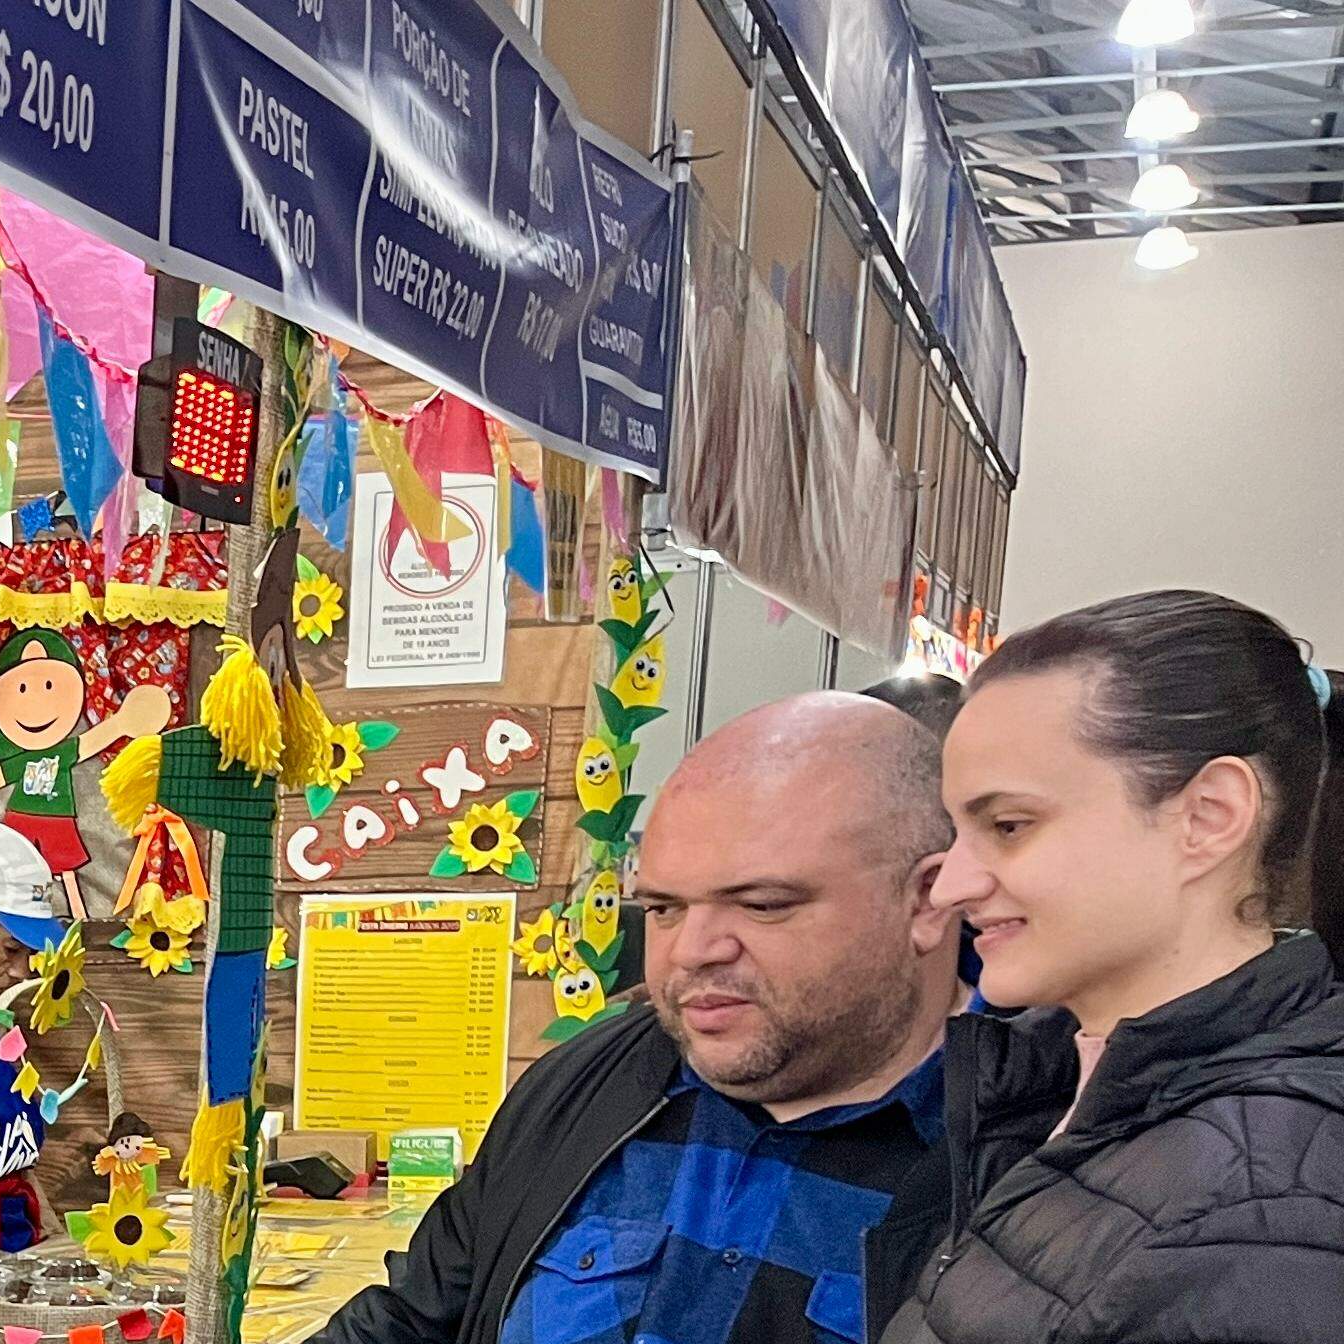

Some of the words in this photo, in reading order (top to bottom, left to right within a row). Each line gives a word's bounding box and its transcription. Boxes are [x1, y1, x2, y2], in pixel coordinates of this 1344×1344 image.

[392, 1, 451, 97] PORÇÃO
[452, 59, 472, 118] DE
[19, 49, 95, 152] 20,00
[238, 76, 314, 180] PASTEL
[373, 234, 430, 310] SUPER
[426, 268, 452, 327] R$
[446, 280, 485, 341] 22,00
[197, 331, 240, 387] SENHA
[381, 615, 419, 626] BEBIDAS
[382, 603, 423, 613] PROIBIDO
[424, 602, 431, 611] A
[432, 601, 461, 611] VENDA
[462, 600, 474, 610] DE
[394, 627, 417, 637] PARA
[419, 626, 460, 636] MENORES
[402, 640, 414, 650] DE
[427, 638, 450, 648] ANOS
[371, 654, 385, 663] LEI
[386, 652, 425, 663] FEDERAL
